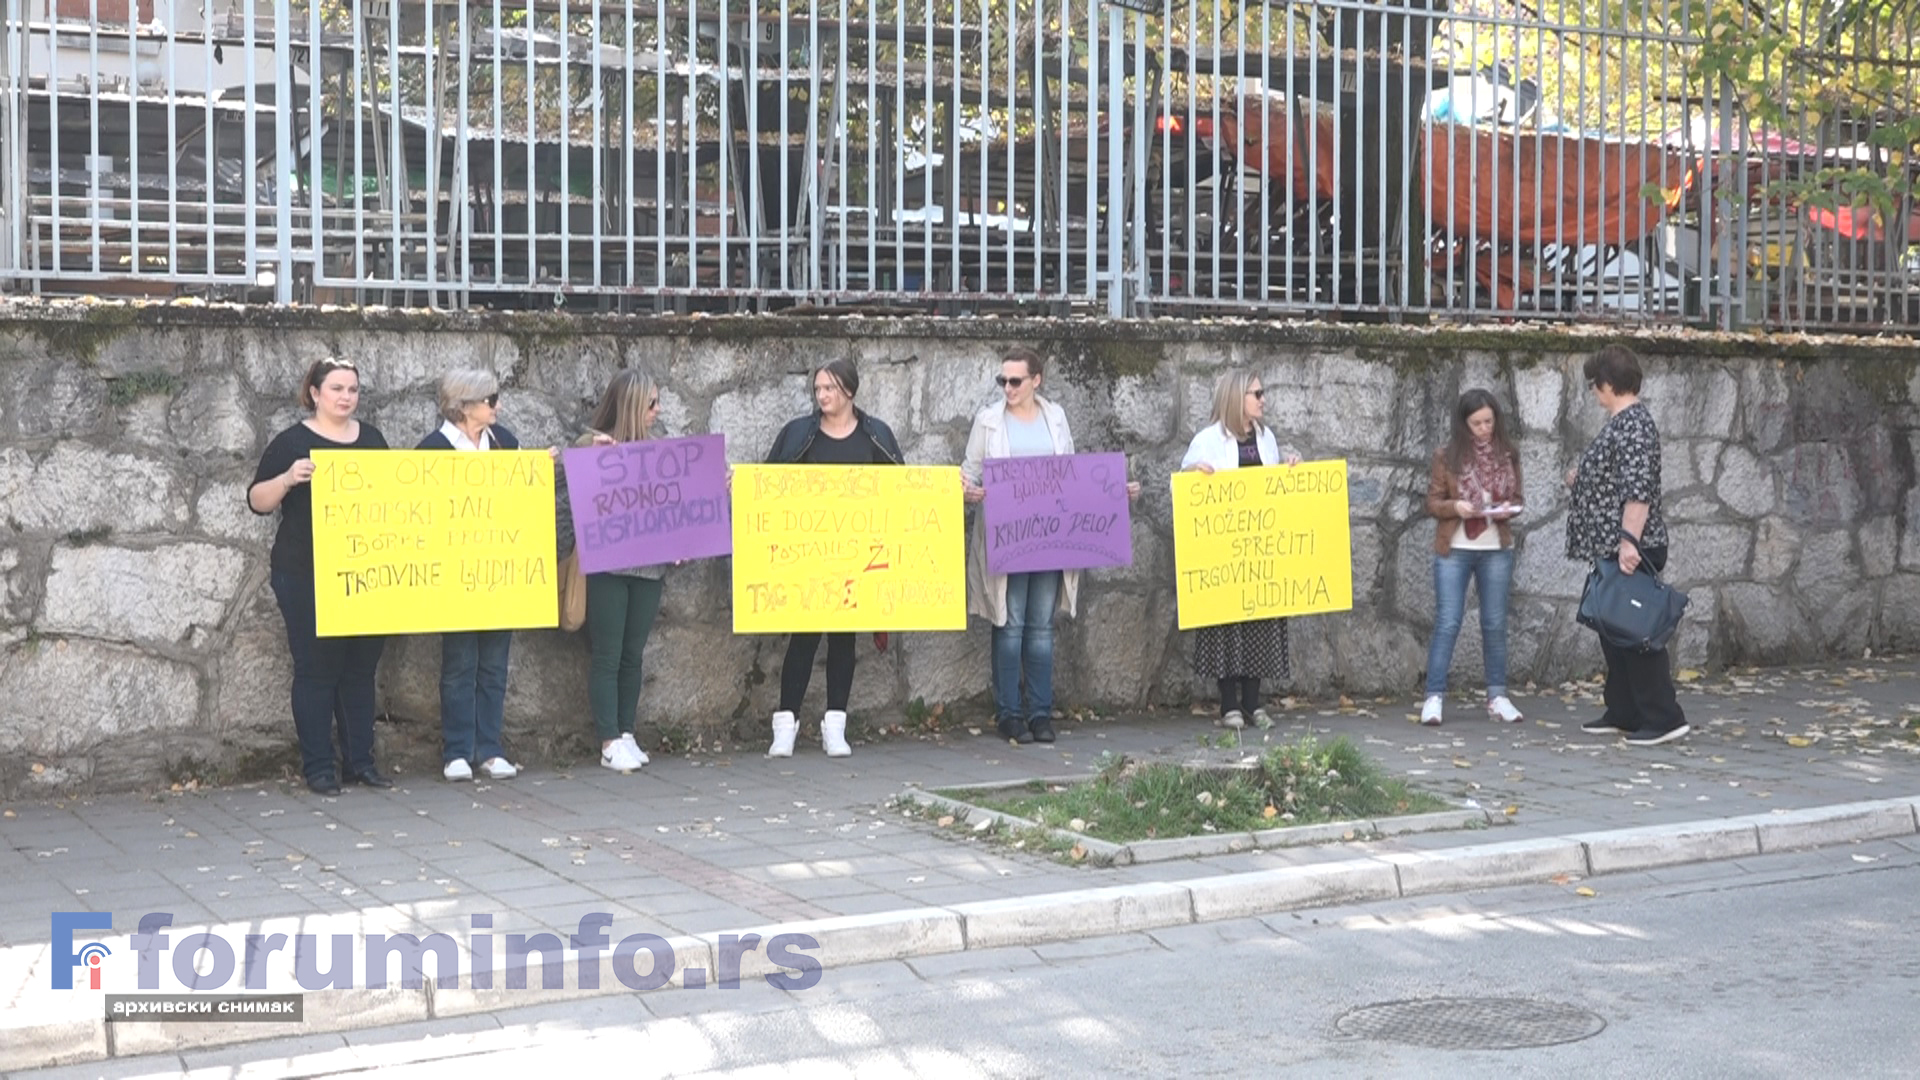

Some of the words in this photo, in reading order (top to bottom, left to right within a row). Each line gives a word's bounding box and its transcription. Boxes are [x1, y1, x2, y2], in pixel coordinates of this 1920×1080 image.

[323, 460, 373, 492] 18.
[595, 441, 705, 487] STOP
[592, 481, 682, 517] RADNOJ
[1189, 479, 1247, 507] SAMO
[1264, 468, 1344, 496] ZAJEDNO
[448, 495, 494, 520] DAN
[745, 511, 772, 536] NE
[782, 507, 890, 534] DOZVOLI
[903, 506, 943, 534] DA
[1193, 507, 1277, 539] MOŽEMO
[993, 512, 1061, 551] KRIVIČNO
[1066, 511, 1119, 537] DELO!
[1230, 528, 1315, 559] SPREČITI
[336, 561, 443, 597] TRGOVINE
[1181, 558, 1275, 594] TRGOVINU
